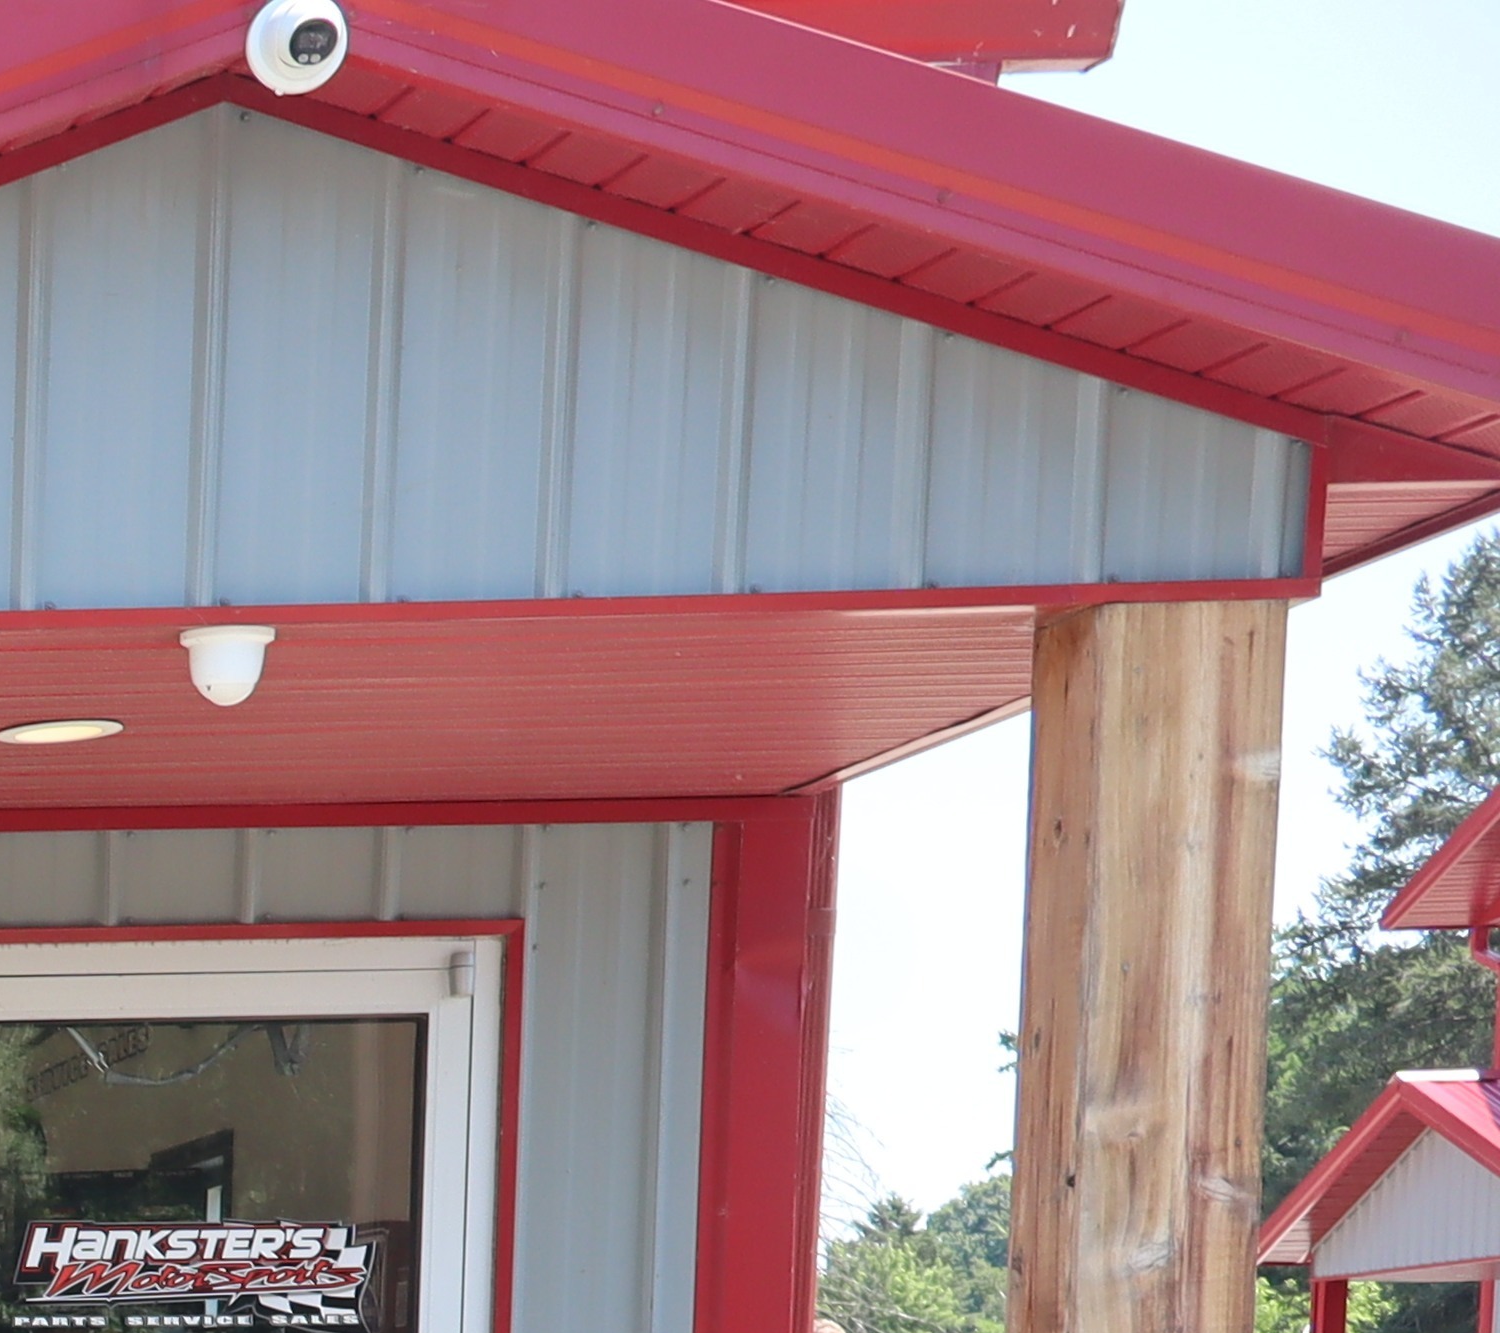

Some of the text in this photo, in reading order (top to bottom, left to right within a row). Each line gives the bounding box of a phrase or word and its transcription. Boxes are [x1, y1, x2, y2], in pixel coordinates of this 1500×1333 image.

[13, 1314, 360, 1327] PARTS SERVICE SALES
